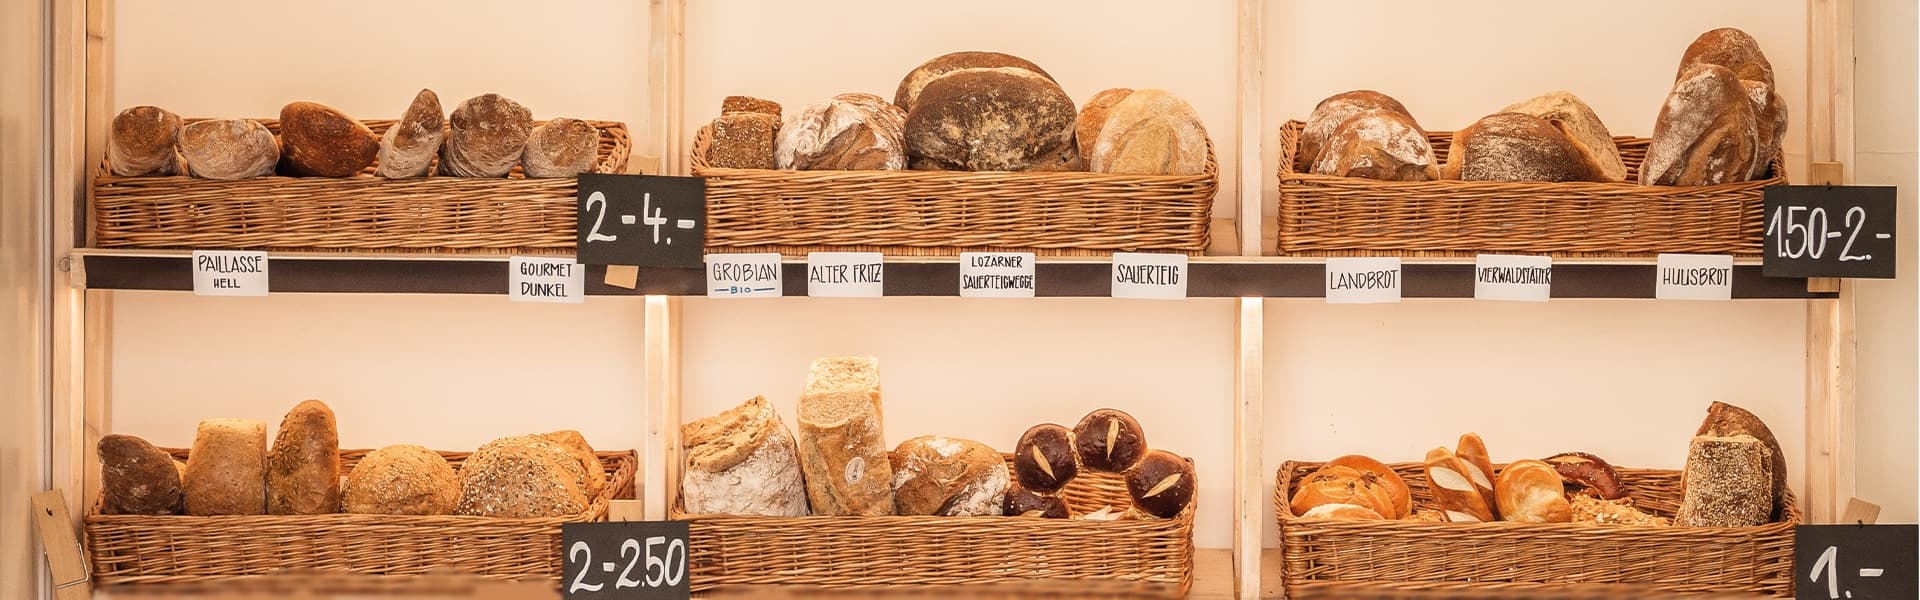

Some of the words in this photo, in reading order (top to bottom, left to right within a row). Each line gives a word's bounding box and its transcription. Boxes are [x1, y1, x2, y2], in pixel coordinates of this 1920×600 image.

[586, 191, 696, 245] 2-4.-
[198, 254, 262, 273] PAILLASSE
[520, 261, 572, 277] GOURMET
[971, 255, 1023, 268] LOZÄRNER
[713, 263, 777, 281] GROBIAN
[810, 265, 848, 283] ALTER
[853, 263, 882, 283] FRITZ
[1116, 263, 1179, 285] SAUERTEIG
[1330, 269, 1399, 290] LANDBROT
[1477, 265, 1552, 285] VIERWALDSTÄTTER
[1663, 267, 1730, 286] HUUSBROT
[213, 278, 241, 288] HELL
[521, 282, 568, 297] DUNKEL
[730, 286, 752, 294] BIO
[962, 274, 1034, 290] SAUERTEIGWEGGE
[569, 536, 686, 594] 2-2.50
[1809, 545, 1884, 599] 1.-
